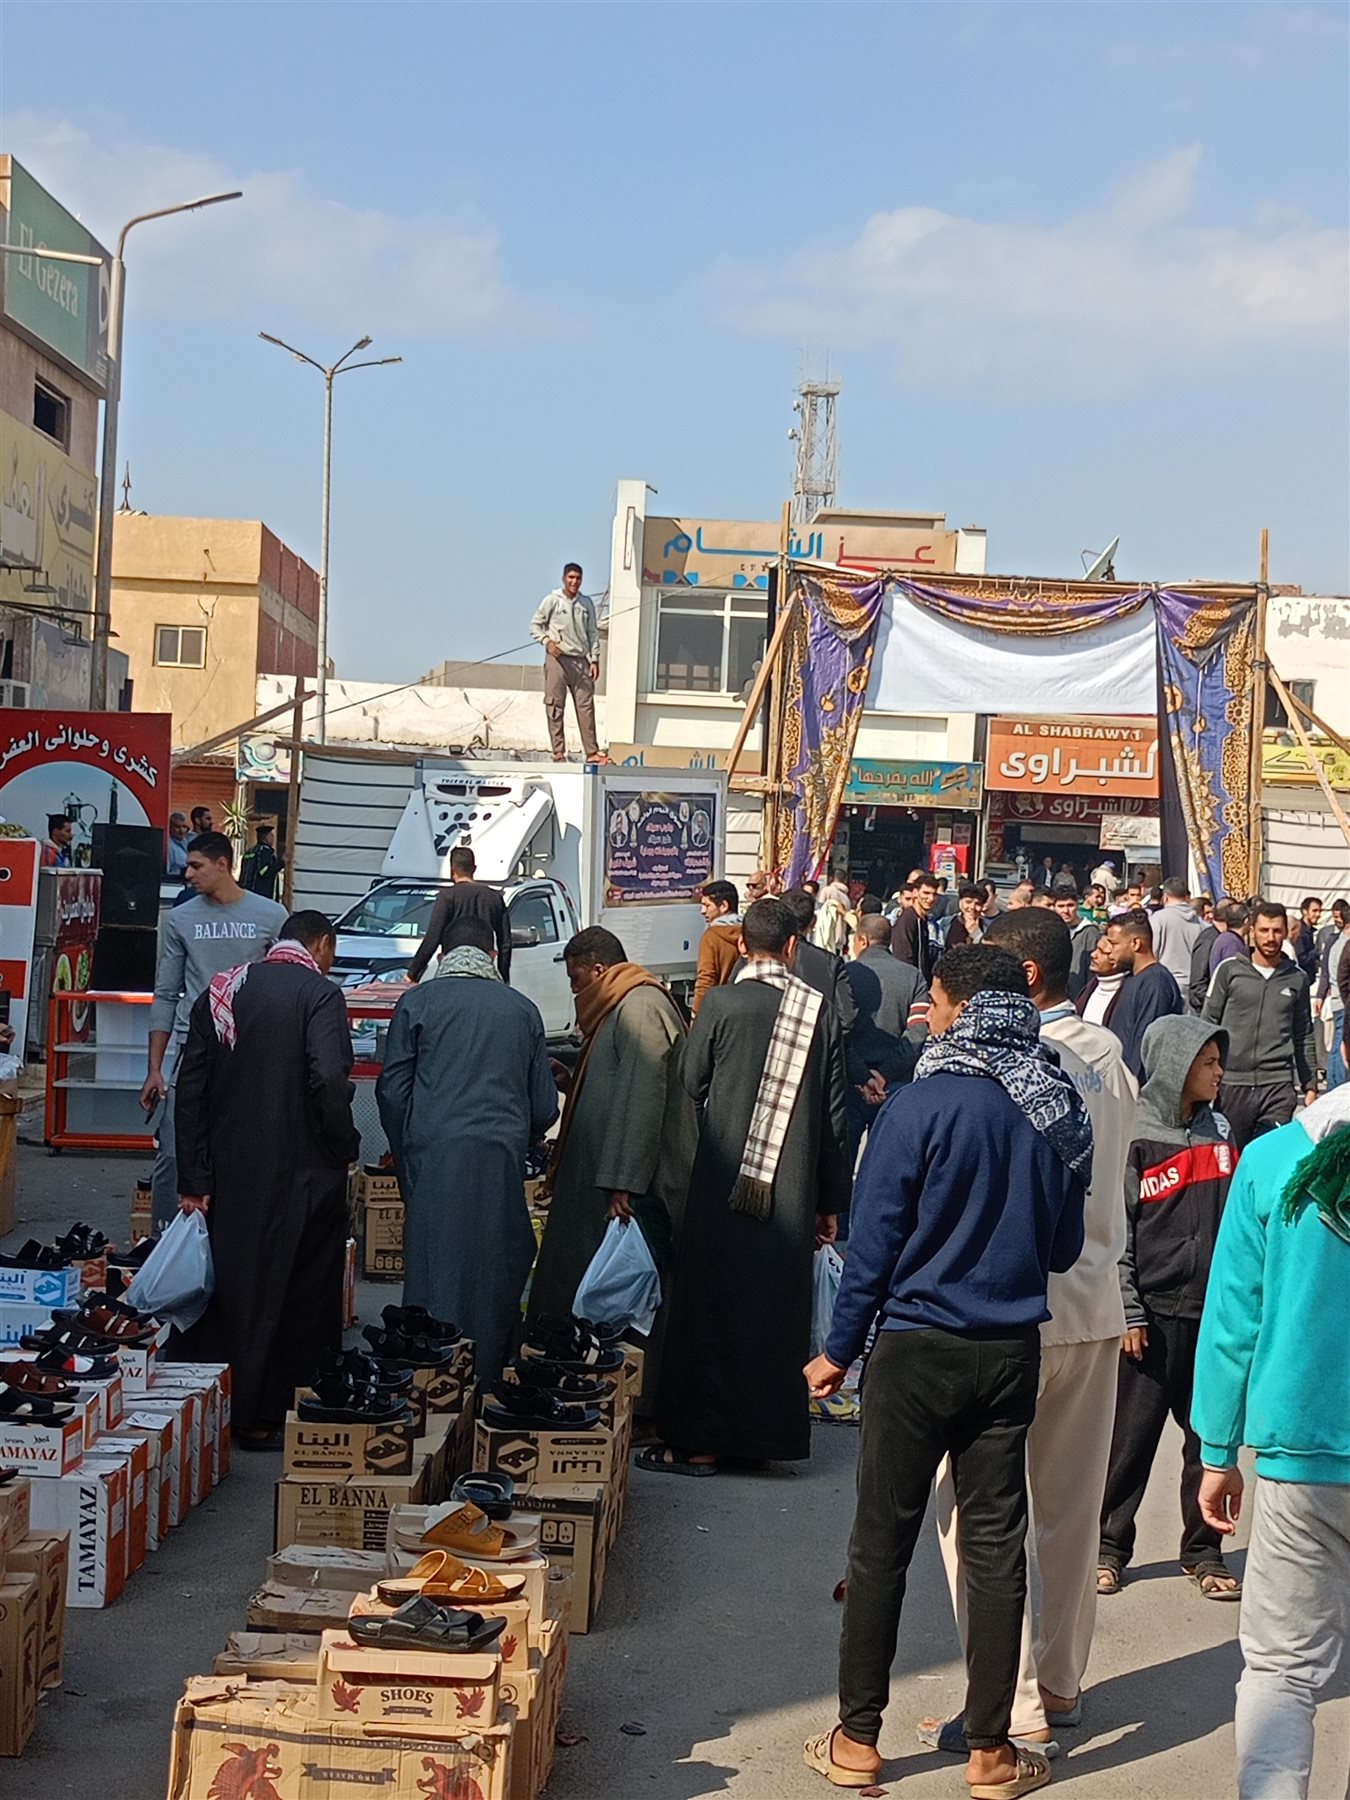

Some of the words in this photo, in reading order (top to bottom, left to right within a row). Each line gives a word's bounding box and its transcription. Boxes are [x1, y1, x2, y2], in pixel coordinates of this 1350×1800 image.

[18, 222, 34, 281] El
[36, 240, 78, 318] Gezera
[1013, 724, 1033, 735] AL
[1039, 725, 1131, 740] SHABRAWY
[113, 745, 158, 788] كشرى
[910, 769, 933, 786] الله
[194, 922, 256, 939] BALANCE
[298, 1431, 350, 1450] البنا
[552, 1456, 601, 1474] البنا
[300, 1487, 322, 1505] EL
[328, 1488, 388, 1508] BANNA
[78, 1486, 97, 1592] TAMAYAZ
[381, 1688, 434, 1704] SHOES
